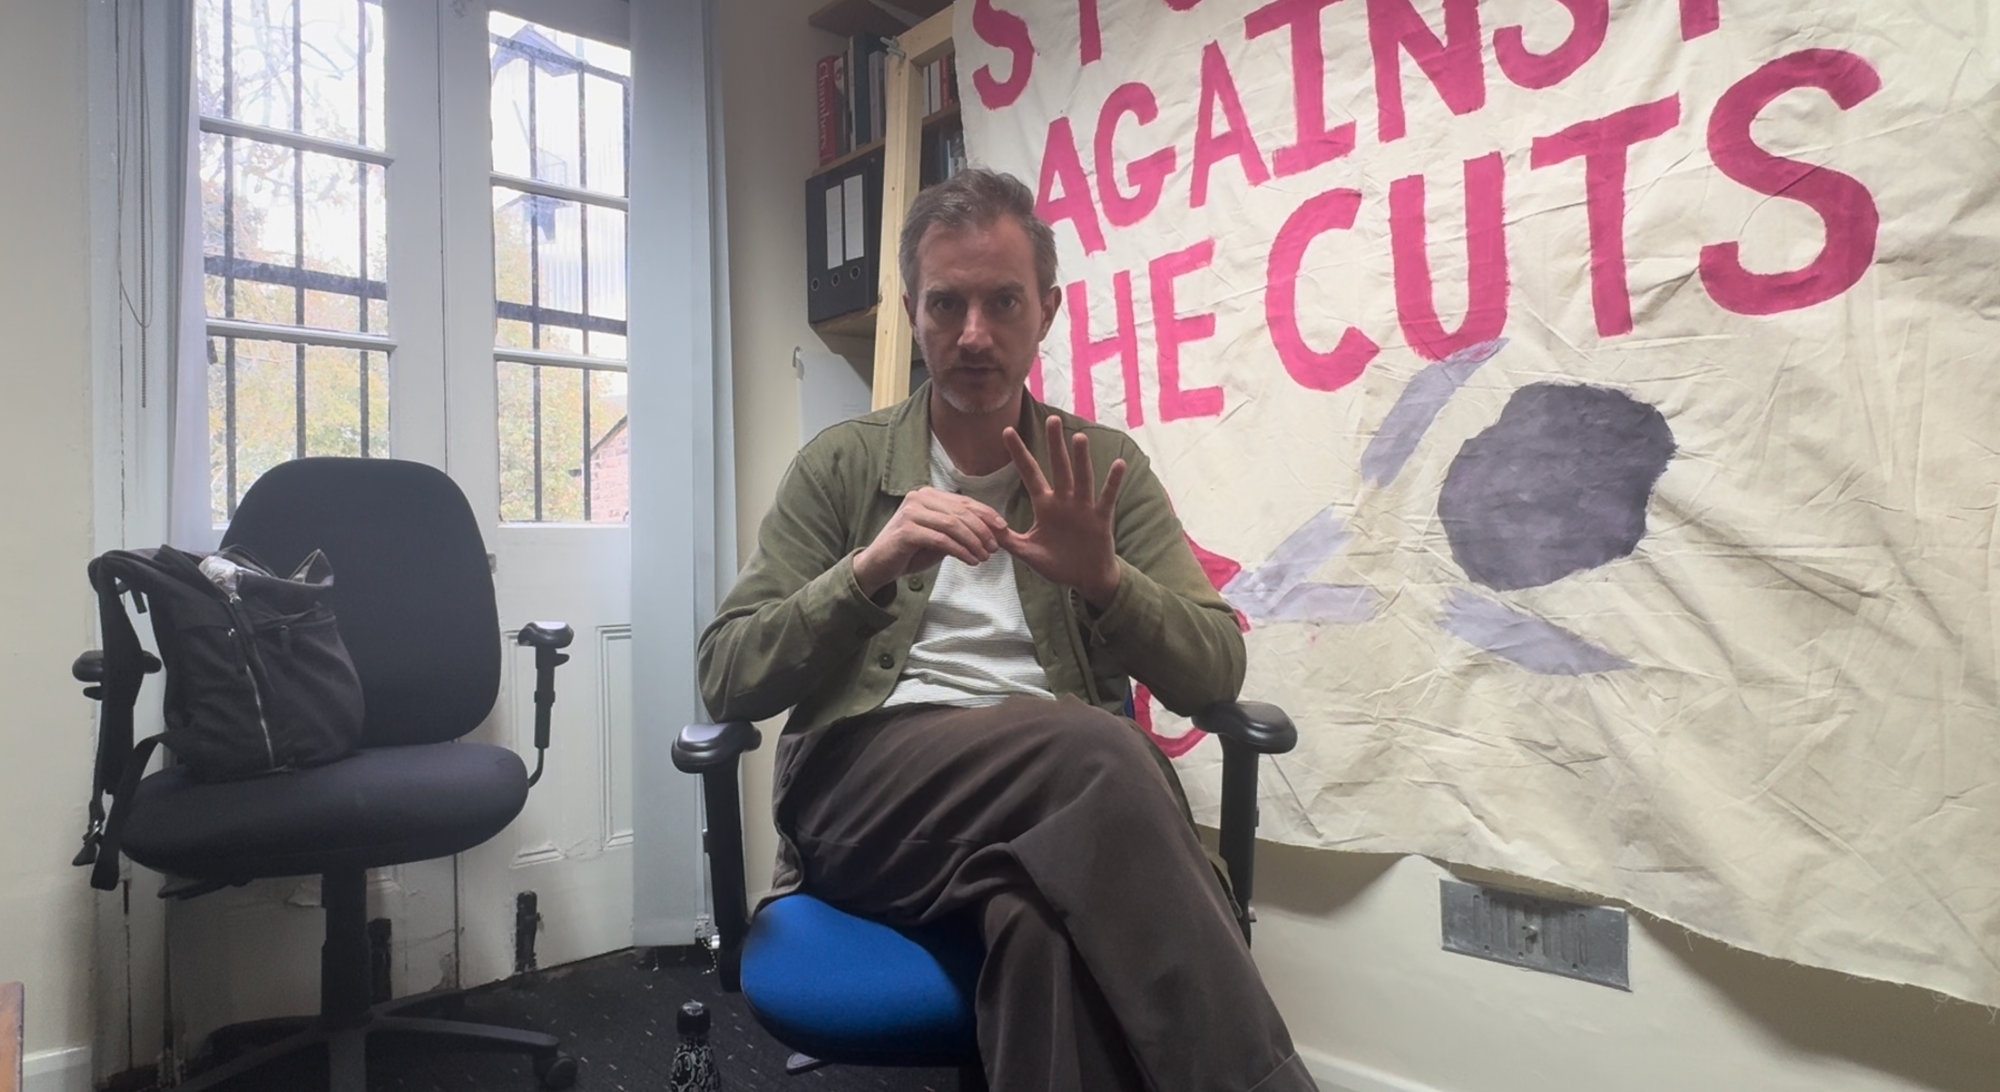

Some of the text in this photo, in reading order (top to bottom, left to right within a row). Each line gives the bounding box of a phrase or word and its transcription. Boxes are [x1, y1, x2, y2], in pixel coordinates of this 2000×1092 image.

[819, 62, 830, 150] Chambers
[1034, 0, 1719, 256] AGAIN
[1028, 236, 1225, 430] HE
[1264, 48, 1881, 393] CUTS
